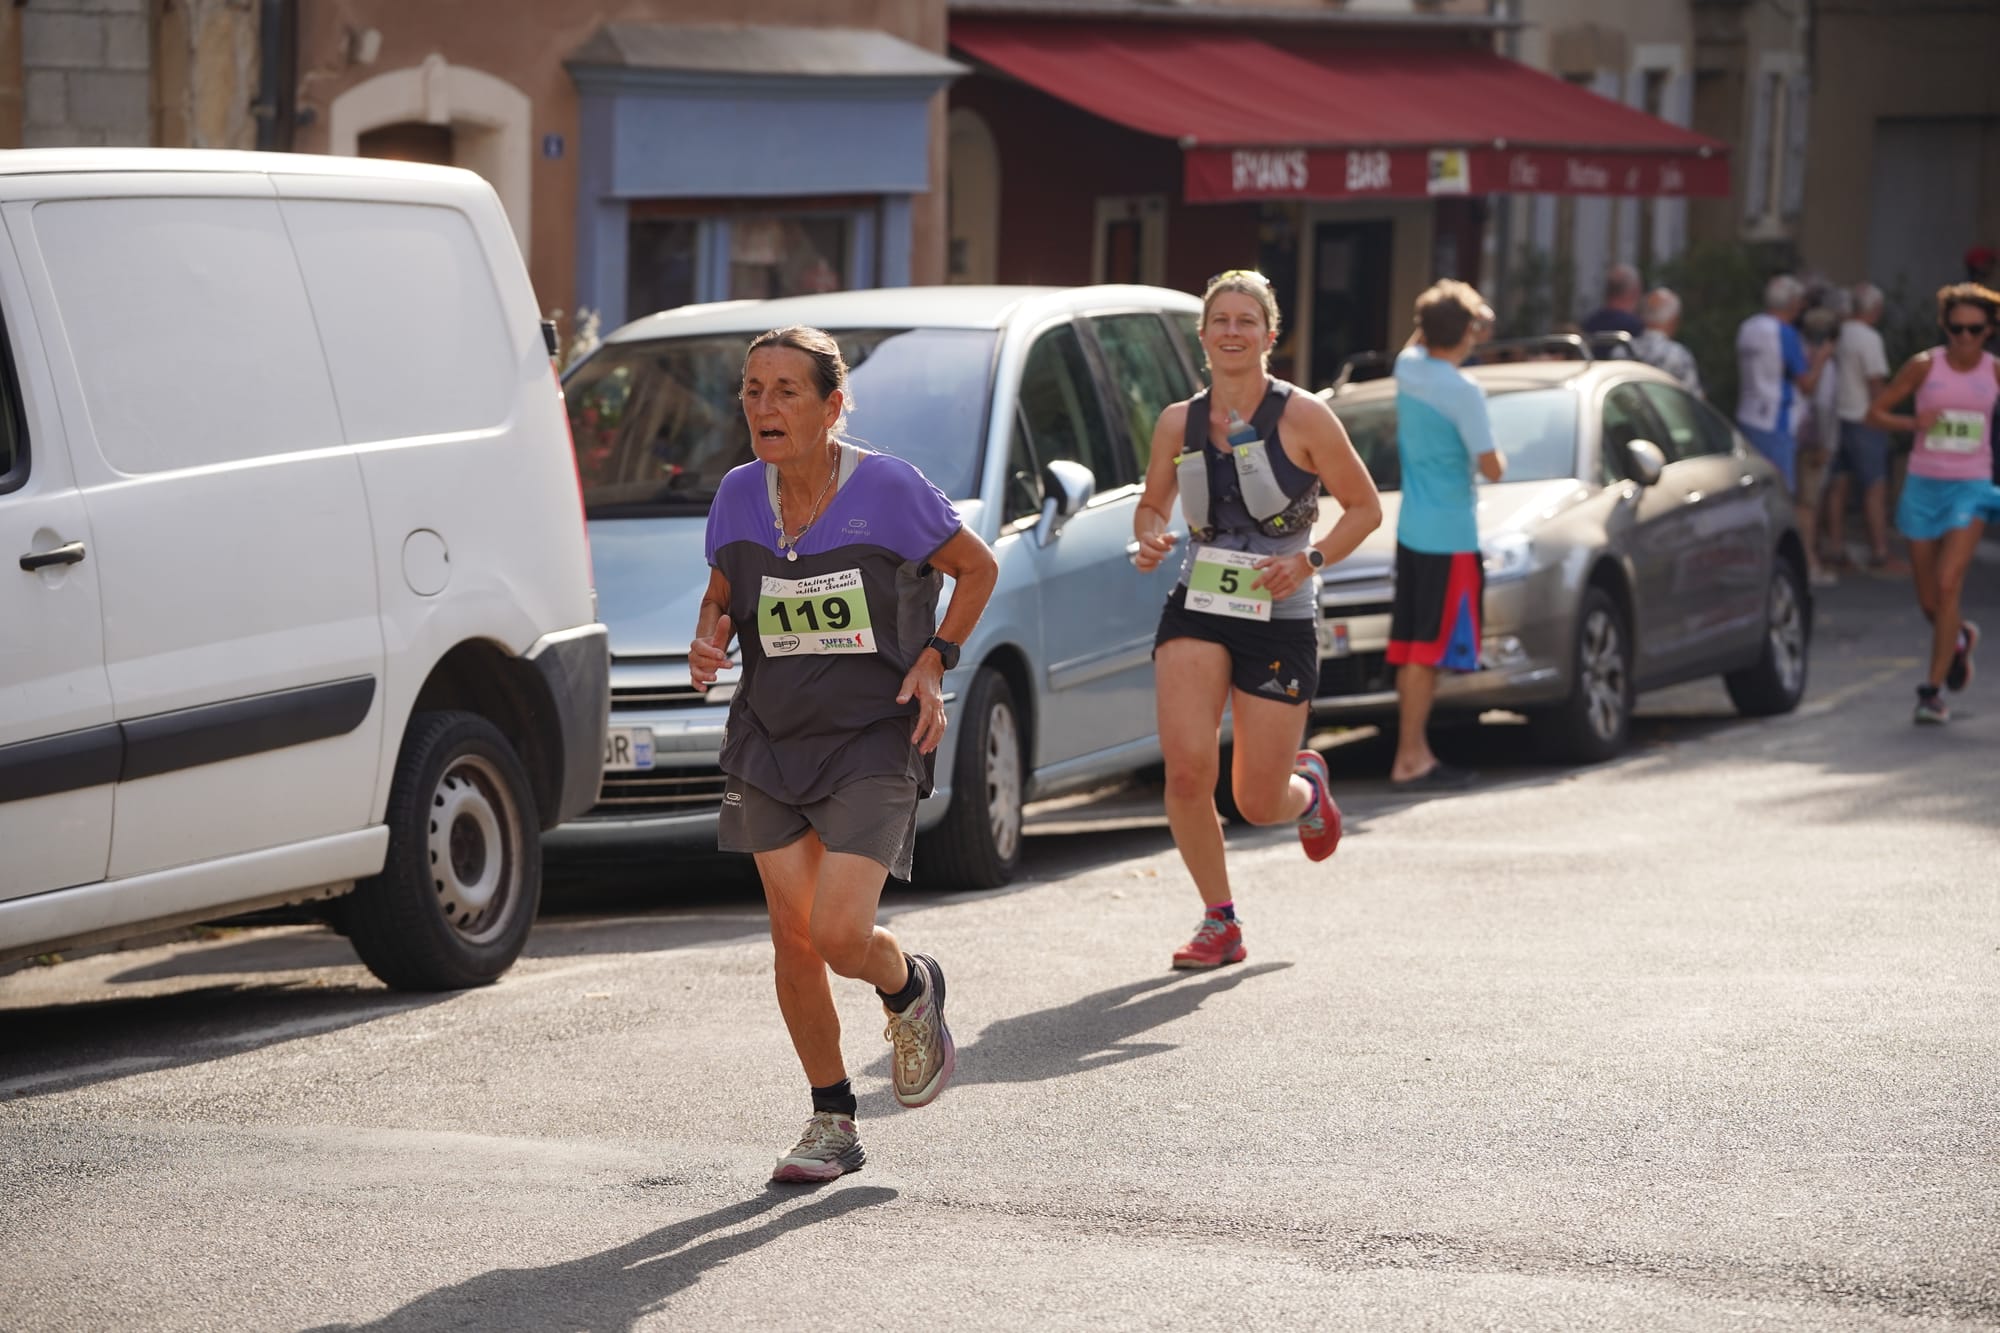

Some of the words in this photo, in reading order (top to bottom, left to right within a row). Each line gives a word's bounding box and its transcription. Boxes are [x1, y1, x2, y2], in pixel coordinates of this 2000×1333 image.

[1232, 150, 1308, 190] RYAN'S
[1345, 149, 1391, 190] BAR
[1945, 422, 1969, 437] 18
[797, 576, 835, 588] Challenge
[1219, 568, 1240, 595] 5
[770, 597, 851, 632] 119
[818, 637, 854, 646] TUFF'S
